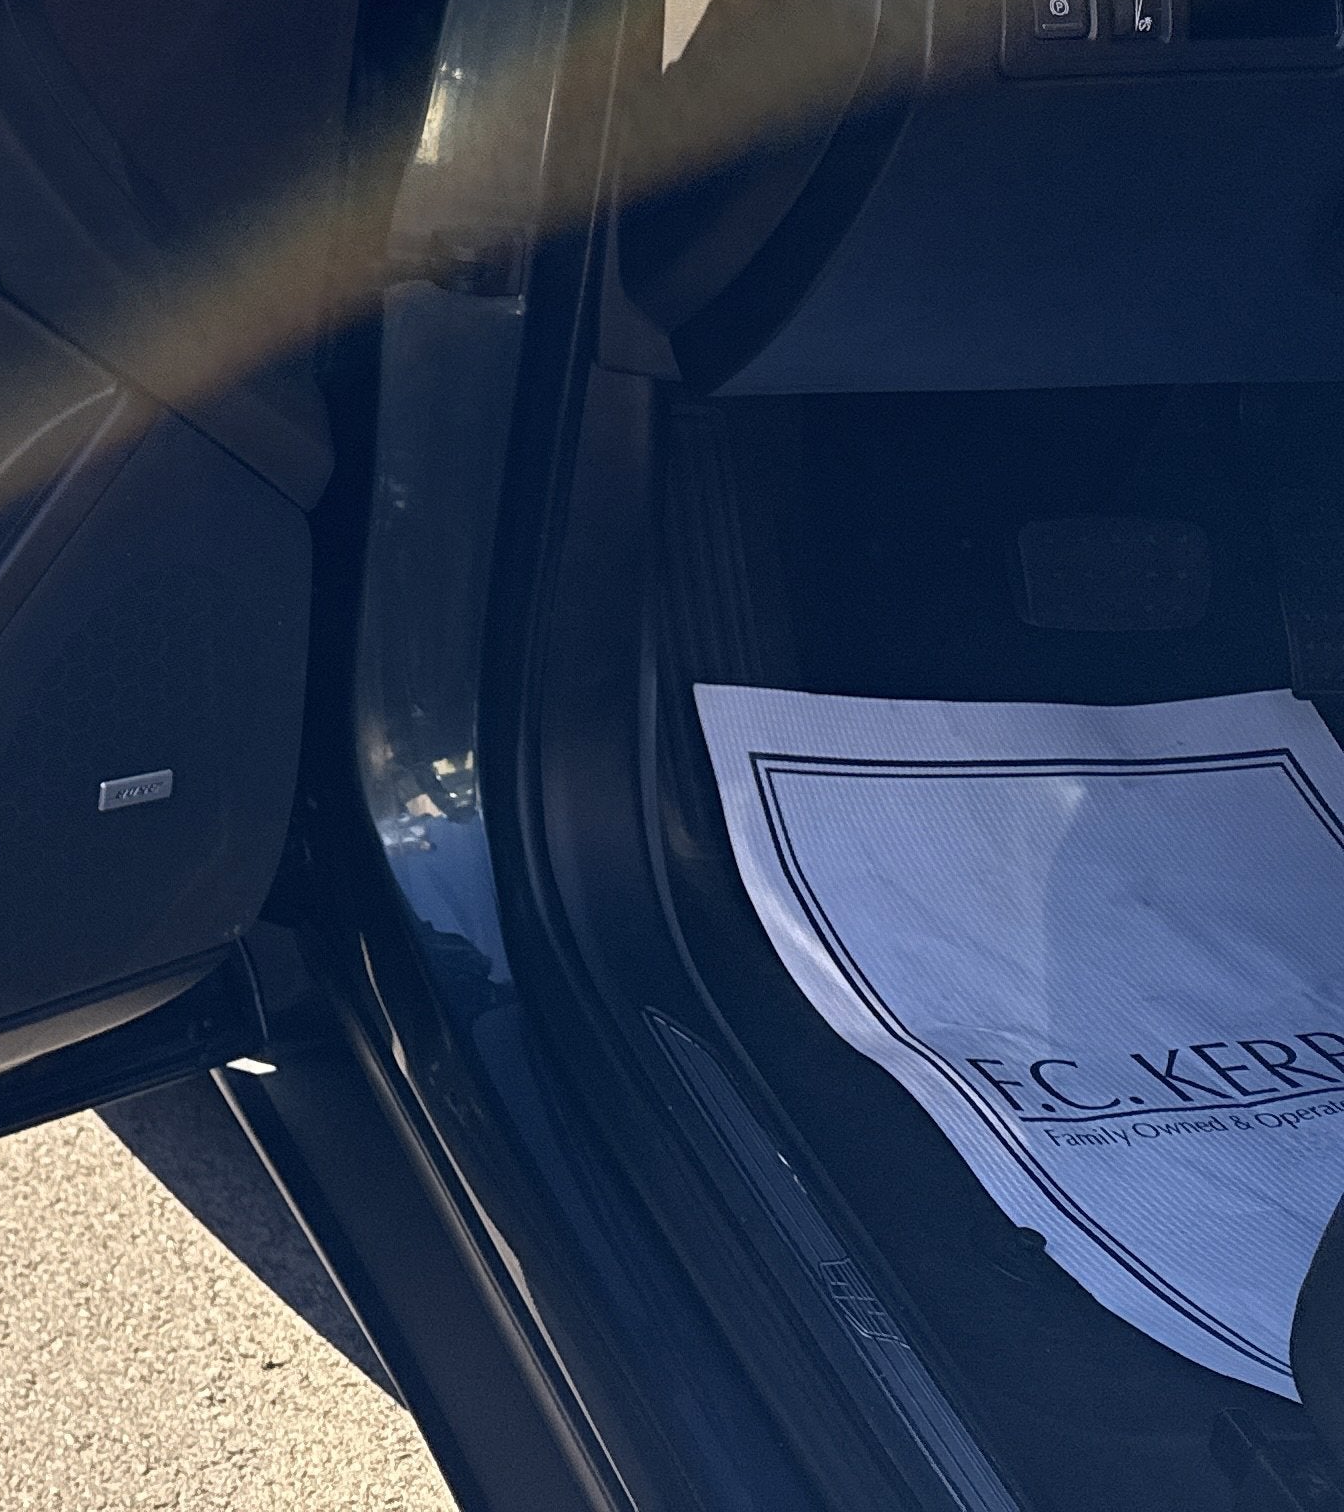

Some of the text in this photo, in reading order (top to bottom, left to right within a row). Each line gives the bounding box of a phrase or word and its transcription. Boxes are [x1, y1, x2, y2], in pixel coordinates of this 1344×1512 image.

[1043, 1125, 1134, 1148] Family
[1130, 1115, 1225, 1140] Owned
[1229, 1115, 1255, 1130] &
